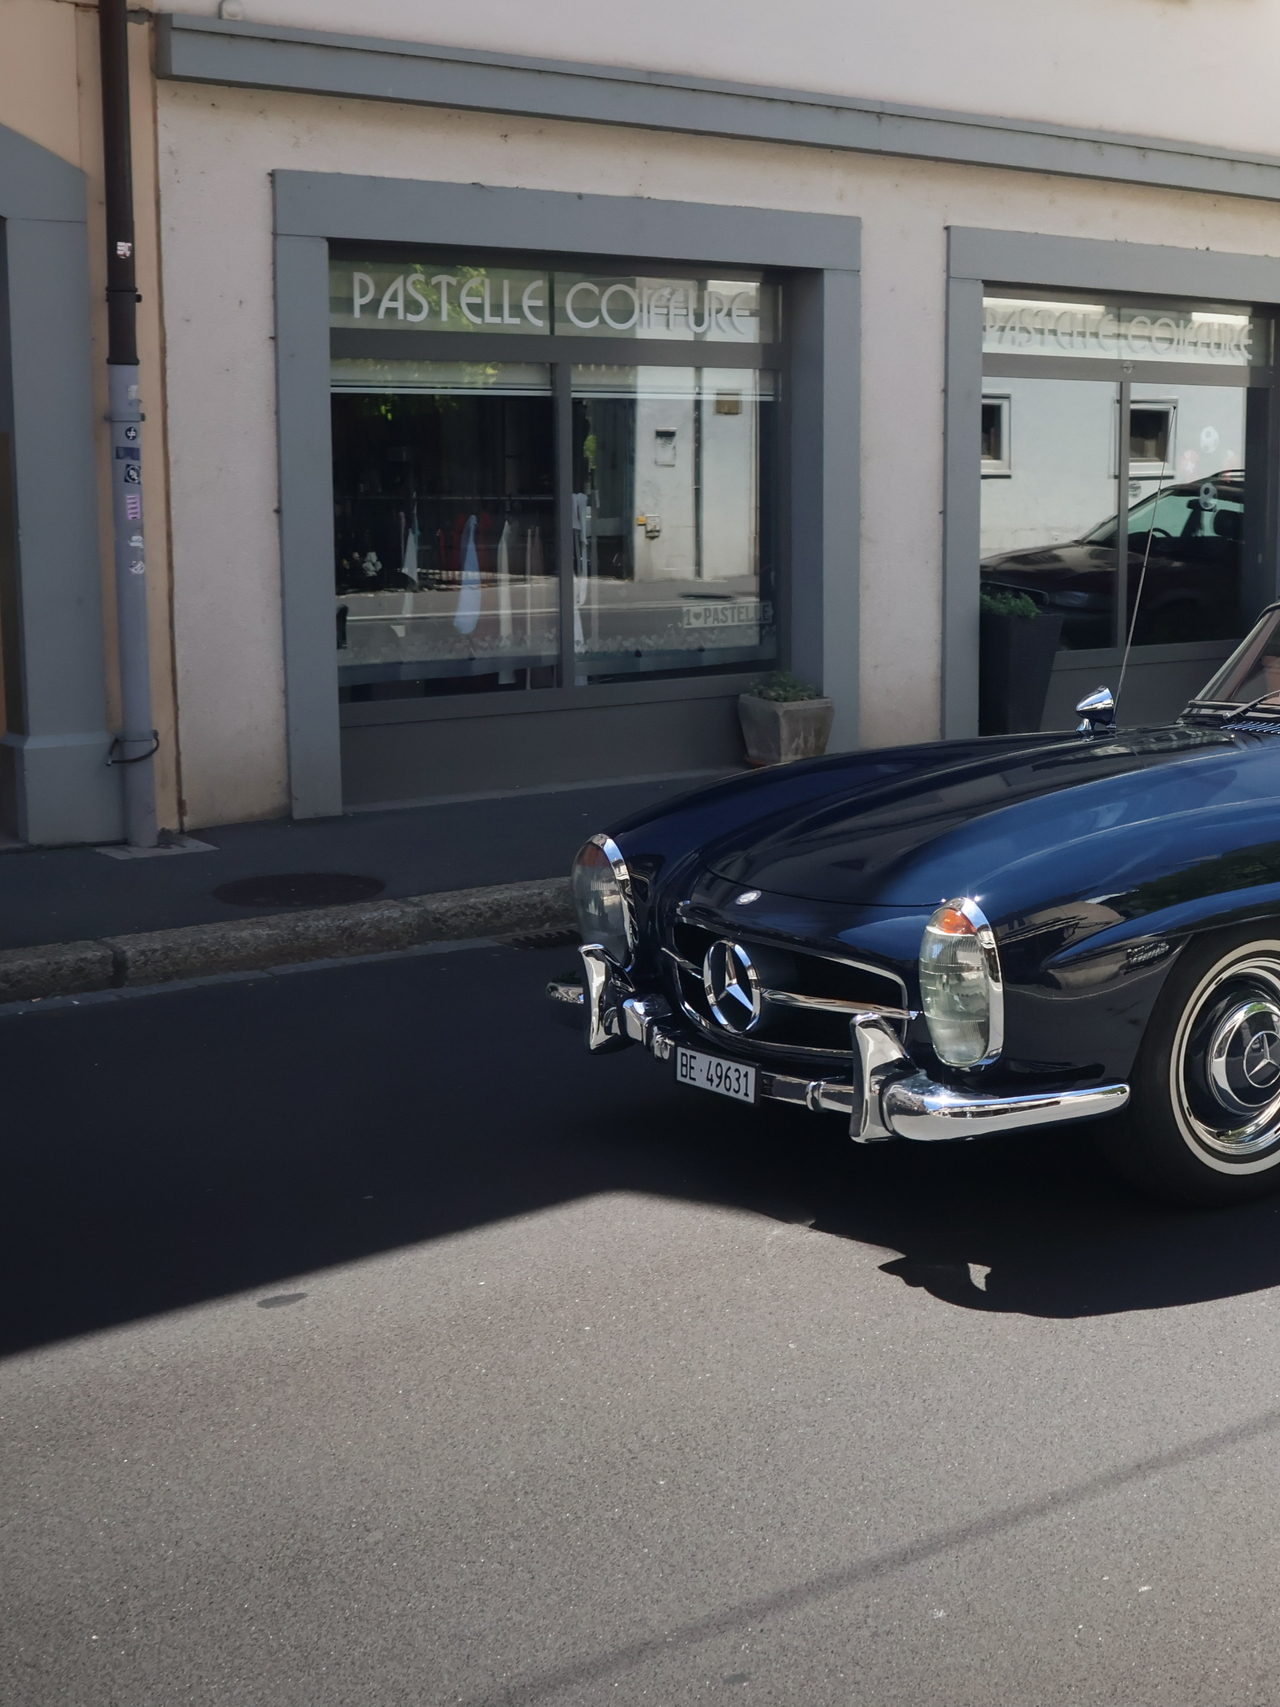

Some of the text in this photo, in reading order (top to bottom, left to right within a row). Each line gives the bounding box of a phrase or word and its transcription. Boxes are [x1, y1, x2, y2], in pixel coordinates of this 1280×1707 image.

[353, 271, 751, 335] PASTELLE COIFFURE
[985, 306, 1114, 352] PASTELLE
[703, 605, 770, 625] PASTELLE
